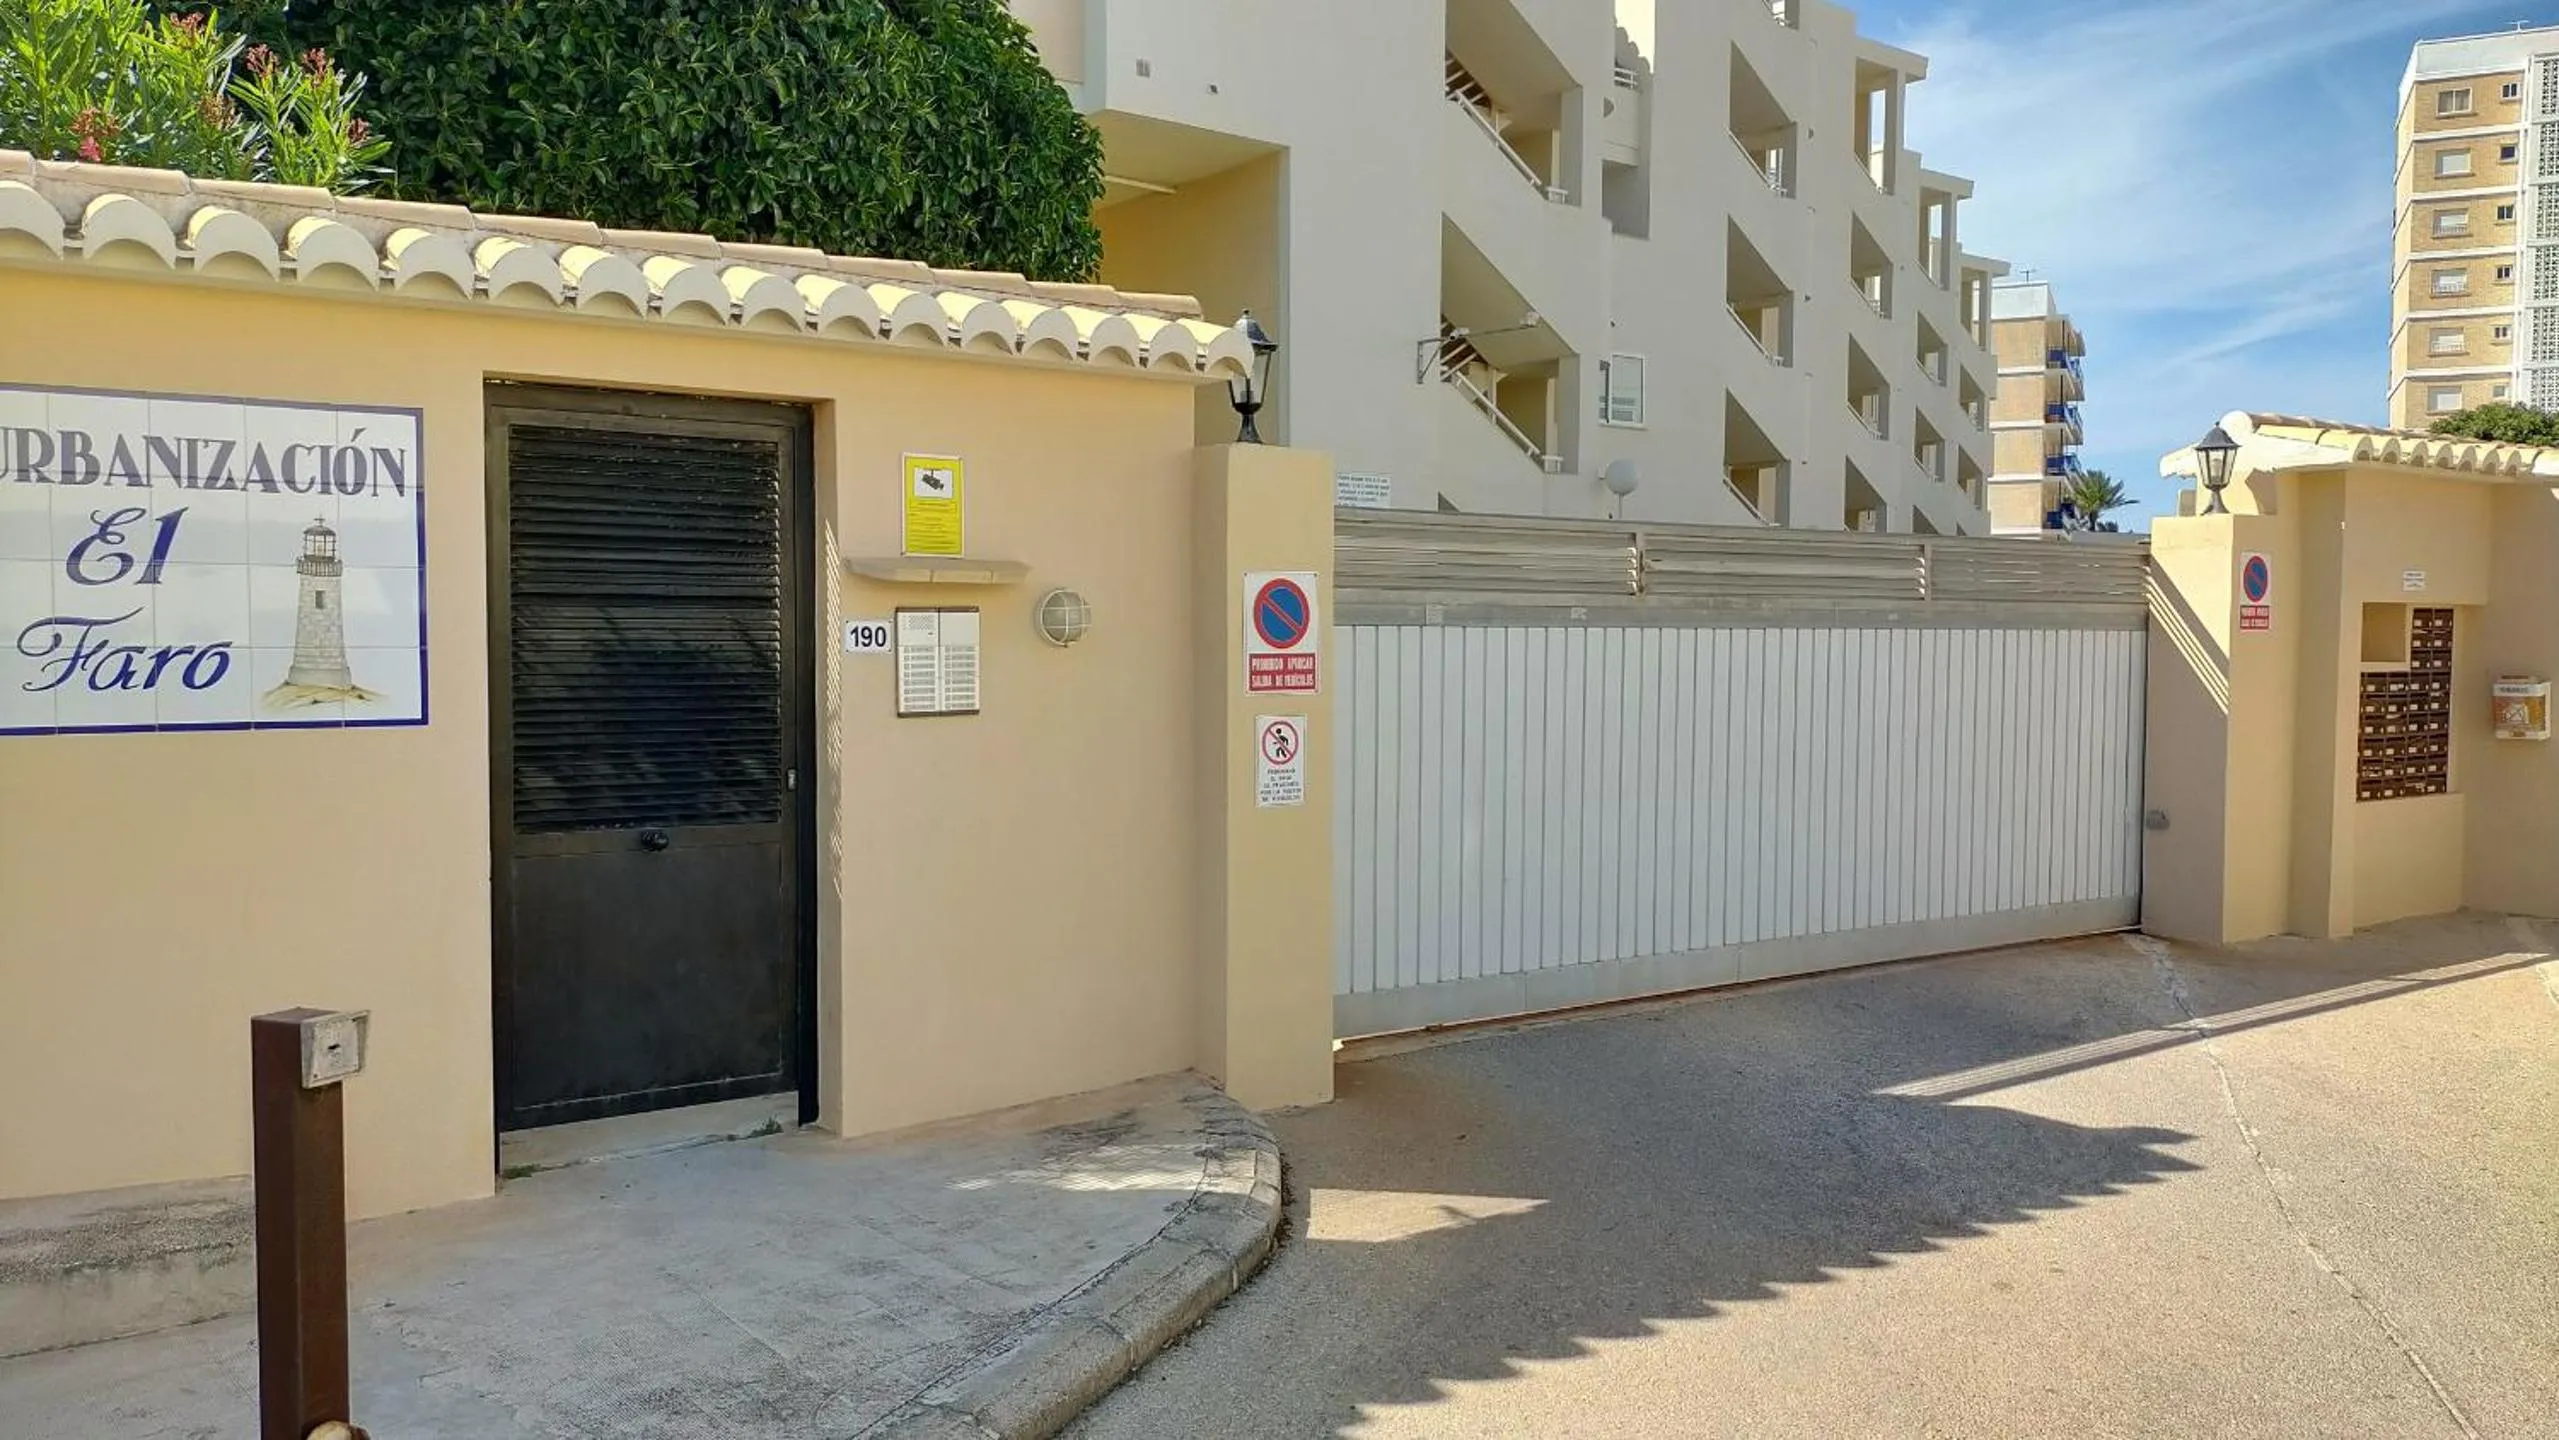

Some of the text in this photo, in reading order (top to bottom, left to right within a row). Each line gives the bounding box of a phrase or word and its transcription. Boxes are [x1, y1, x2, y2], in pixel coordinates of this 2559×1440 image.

[0, 426, 406, 498] RBANIZACIÓN
[65, 507, 189, 586] El
[16, 606, 233, 693] Faro
[850, 625, 887, 647] 190
